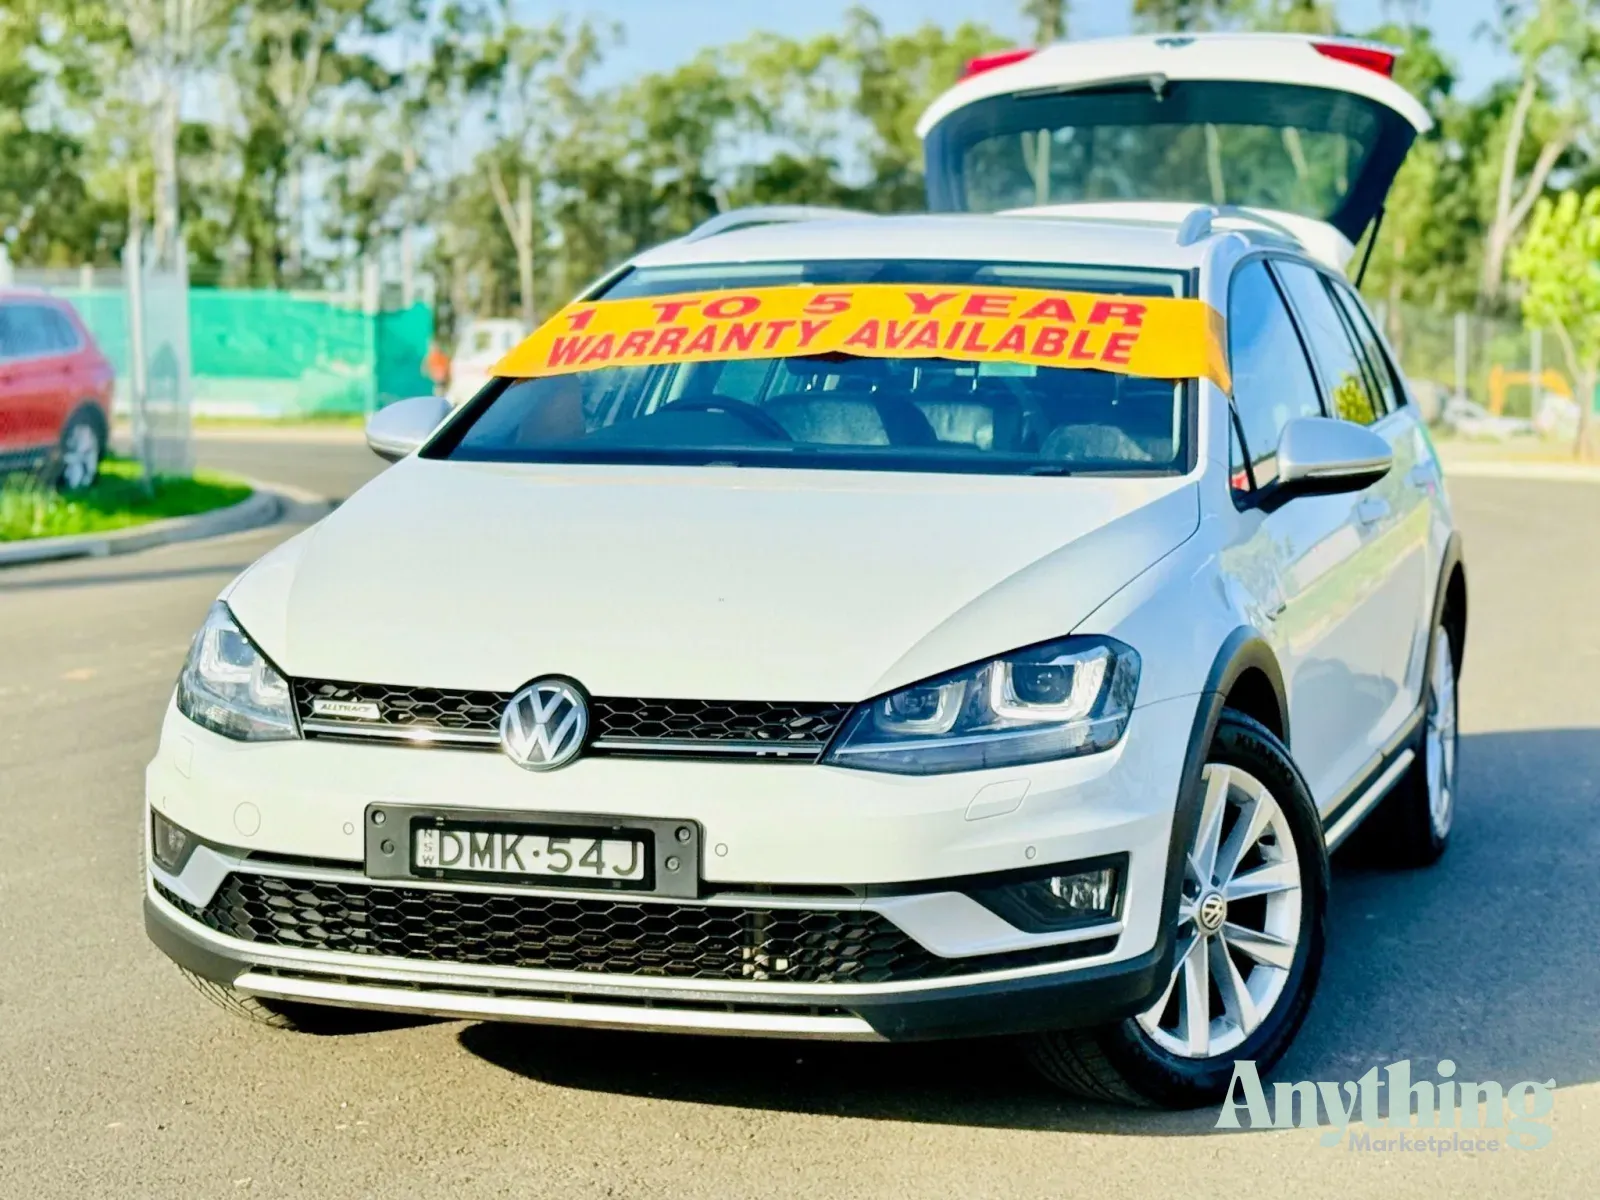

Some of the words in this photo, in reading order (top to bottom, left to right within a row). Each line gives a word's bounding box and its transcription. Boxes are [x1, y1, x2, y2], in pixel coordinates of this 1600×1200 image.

[566, 308, 597, 331] 1
[652, 296, 762, 323] TO
[803, 292, 853, 315] 5
[904, 292, 1148, 328] YEAR
[546, 319, 832, 368] WARRANTY
[844, 318, 1140, 365] AVAILABLE
